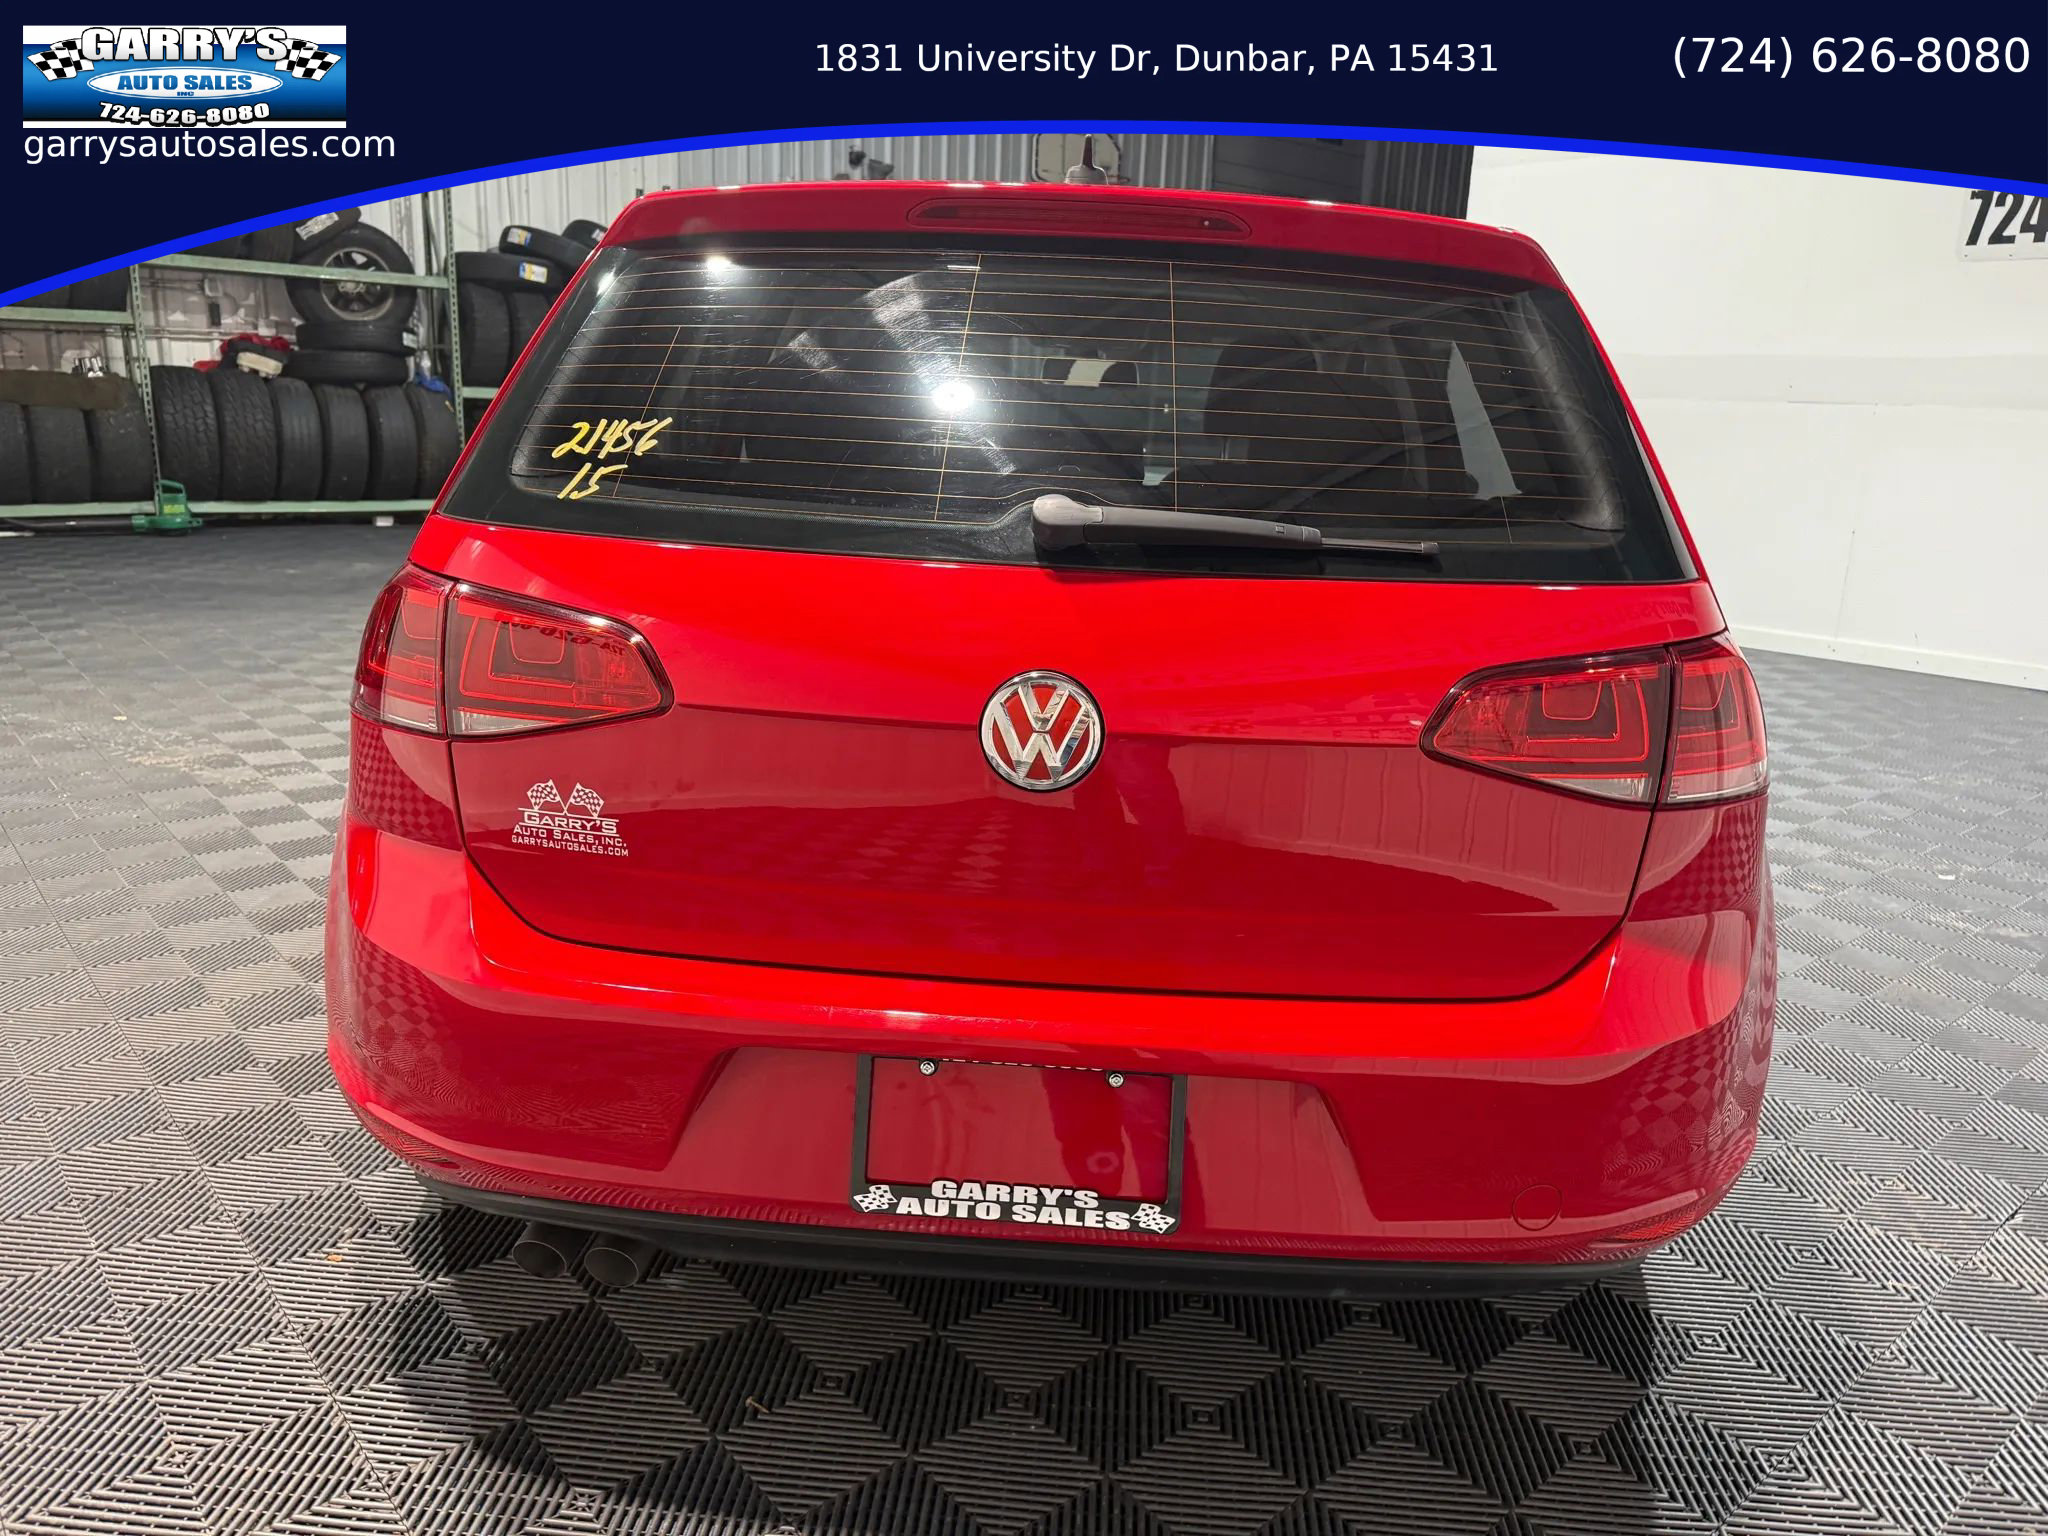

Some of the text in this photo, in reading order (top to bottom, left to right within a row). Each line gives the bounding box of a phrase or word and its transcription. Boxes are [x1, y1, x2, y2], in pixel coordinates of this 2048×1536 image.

[551, 416, 674, 459] 21456
[556, 462, 629, 500] 15
[513, 824, 548, 838] AUTO
[523, 811, 618, 835] GARRY'S
[511, 834, 629, 858] GARRYSAUTOSALES.COM
[930, 1180, 1100, 1209] GARRY'S
[895, 1196, 1131, 1231] AUTO SALES
